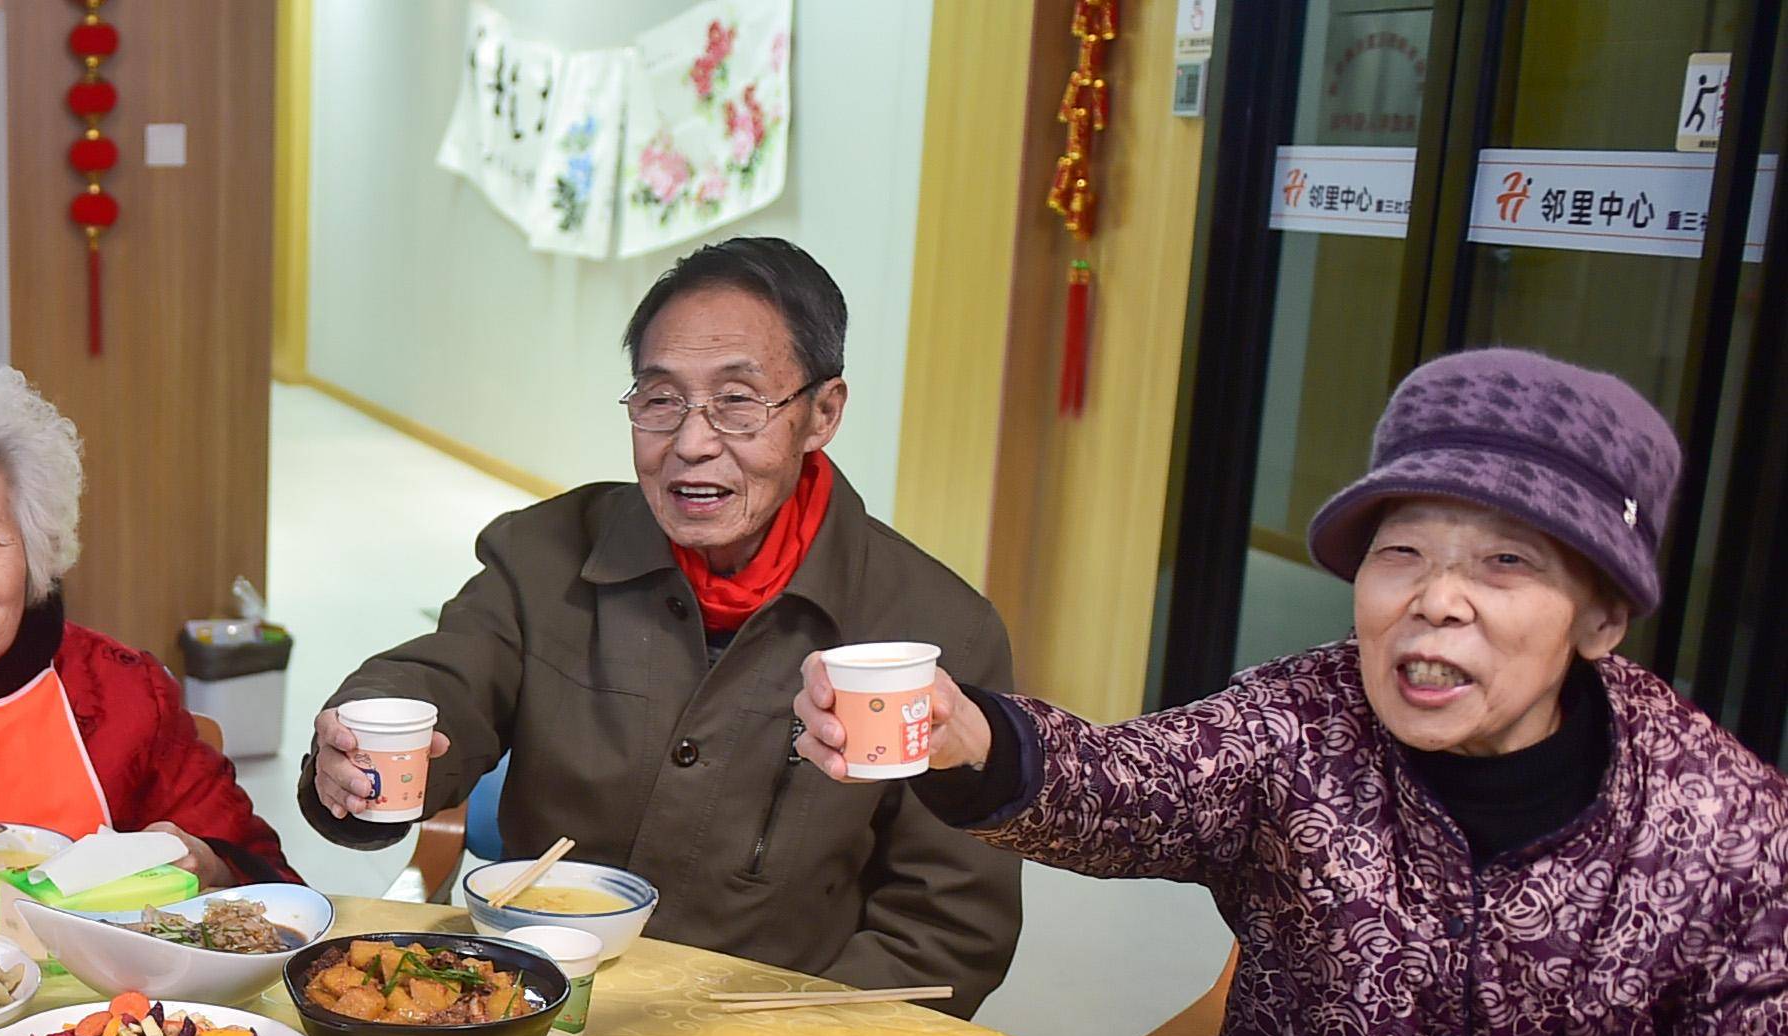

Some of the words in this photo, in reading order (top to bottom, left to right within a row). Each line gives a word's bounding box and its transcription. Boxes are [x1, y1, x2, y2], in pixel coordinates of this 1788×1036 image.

[1309, 184, 1372, 212] 邻里中心
[1540, 187, 1655, 229] 邻里中心
